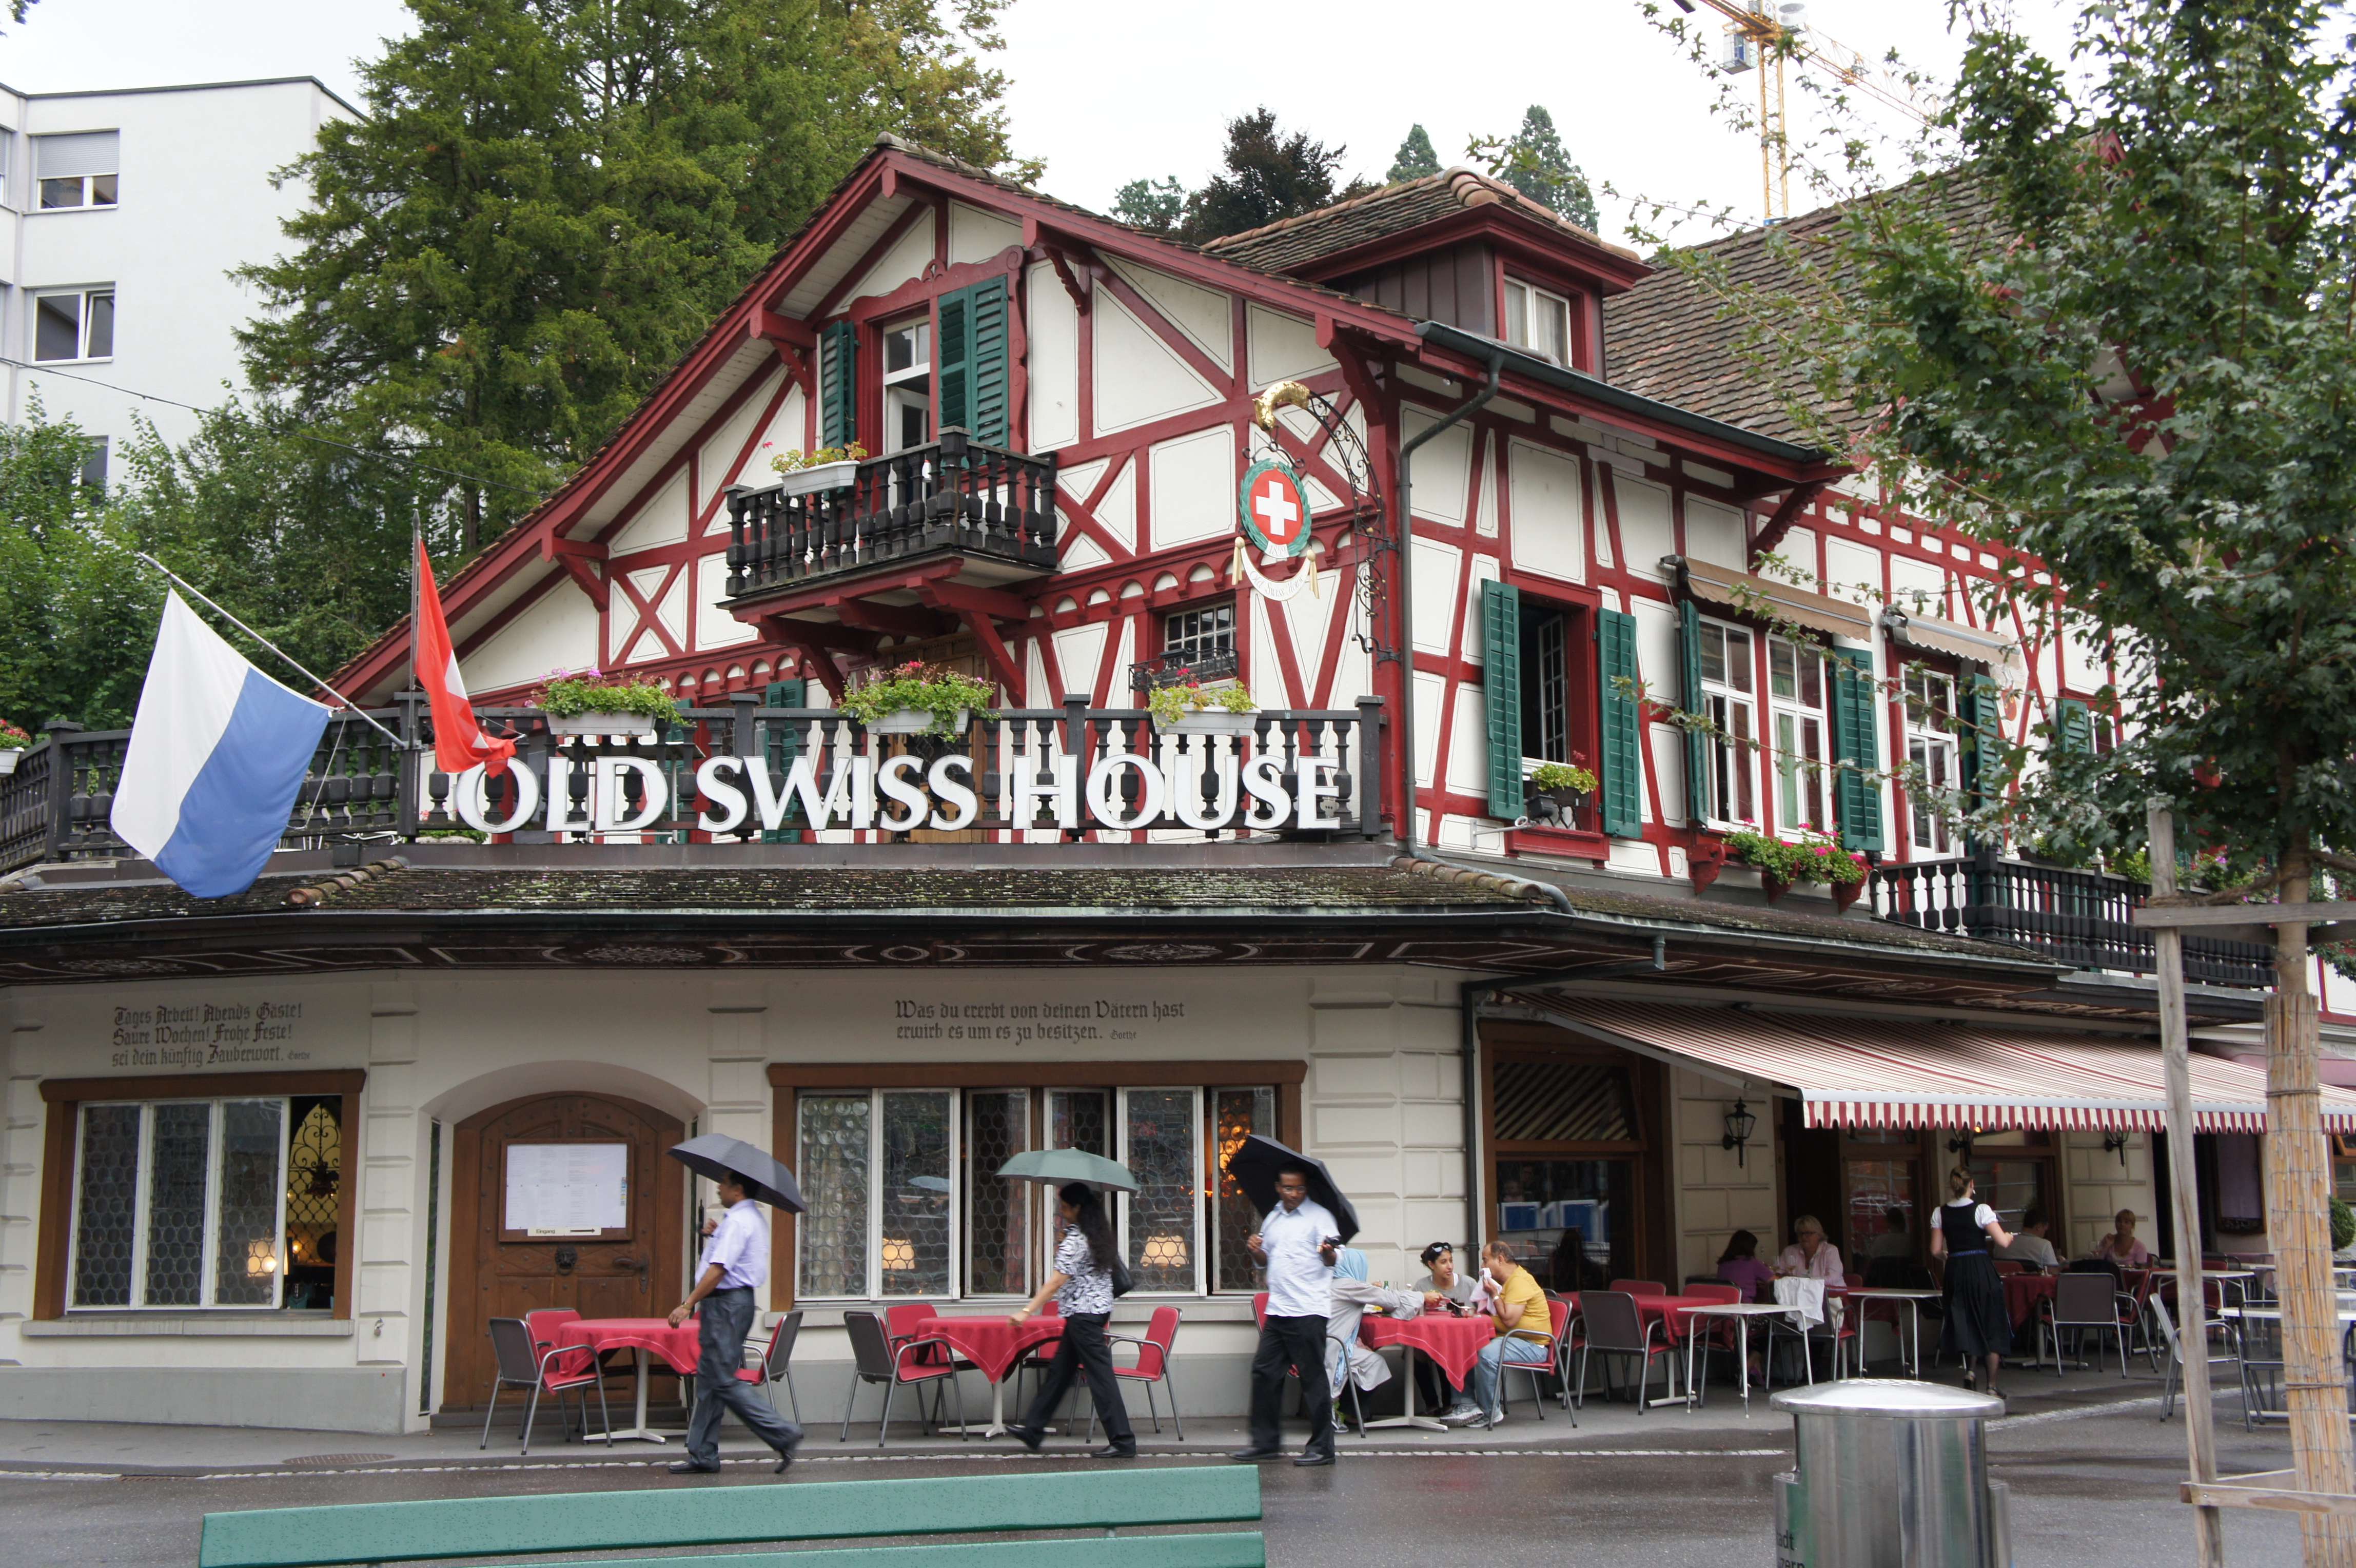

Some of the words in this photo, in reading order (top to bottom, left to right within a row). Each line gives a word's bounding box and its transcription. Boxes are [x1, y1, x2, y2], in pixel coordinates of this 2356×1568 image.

[1249, 571, 1265, 589] Old
[1265, 583, 1285, 597] Swiss
[456, 756, 668, 833] OLD
[696, 754, 978, 832] SWISS
[1013, 753, 1340, 830] HOUSE
[114, 1006, 152, 1029] Tages
[155, 1005, 199, 1025] Arbeit!
[203, 1002, 250, 1024] Abends
[257, 1002, 302, 1020] Gäste!
[895, 999, 934, 1018] Was
[940, 1002, 959, 1018] du
[964, 1002, 1005, 1019] ererbt
[1010, 1003, 1038, 1018] von
[1043, 1002, 1091, 1018] deinen
[1094, 999, 1148, 1018] Vätern
[1152, 999, 1185, 1023] hast
[112, 1028, 150, 1046] Saure
[155, 1025, 210, 1047] Wochen!
[212, 1023, 250, 1047] Frohe
[252, 1021, 292, 1042] Feste!
[897, 1023, 943, 1039] erwirb
[948, 1025, 964, 1040] es
[968, 1025, 991, 1040] um
[996, 1025, 1011, 1040] es
[1015, 1025, 1032, 1047] zu
[1037, 1022, 1103, 1044] besitzen.
[1109, 1029, 1137, 1041] Goethe
[112, 1050, 128, 1067] sei
[132, 1047, 157, 1065] dein
[161, 1046, 204, 1068] künftig
[206, 1044, 284, 1064] Zauberwort.
